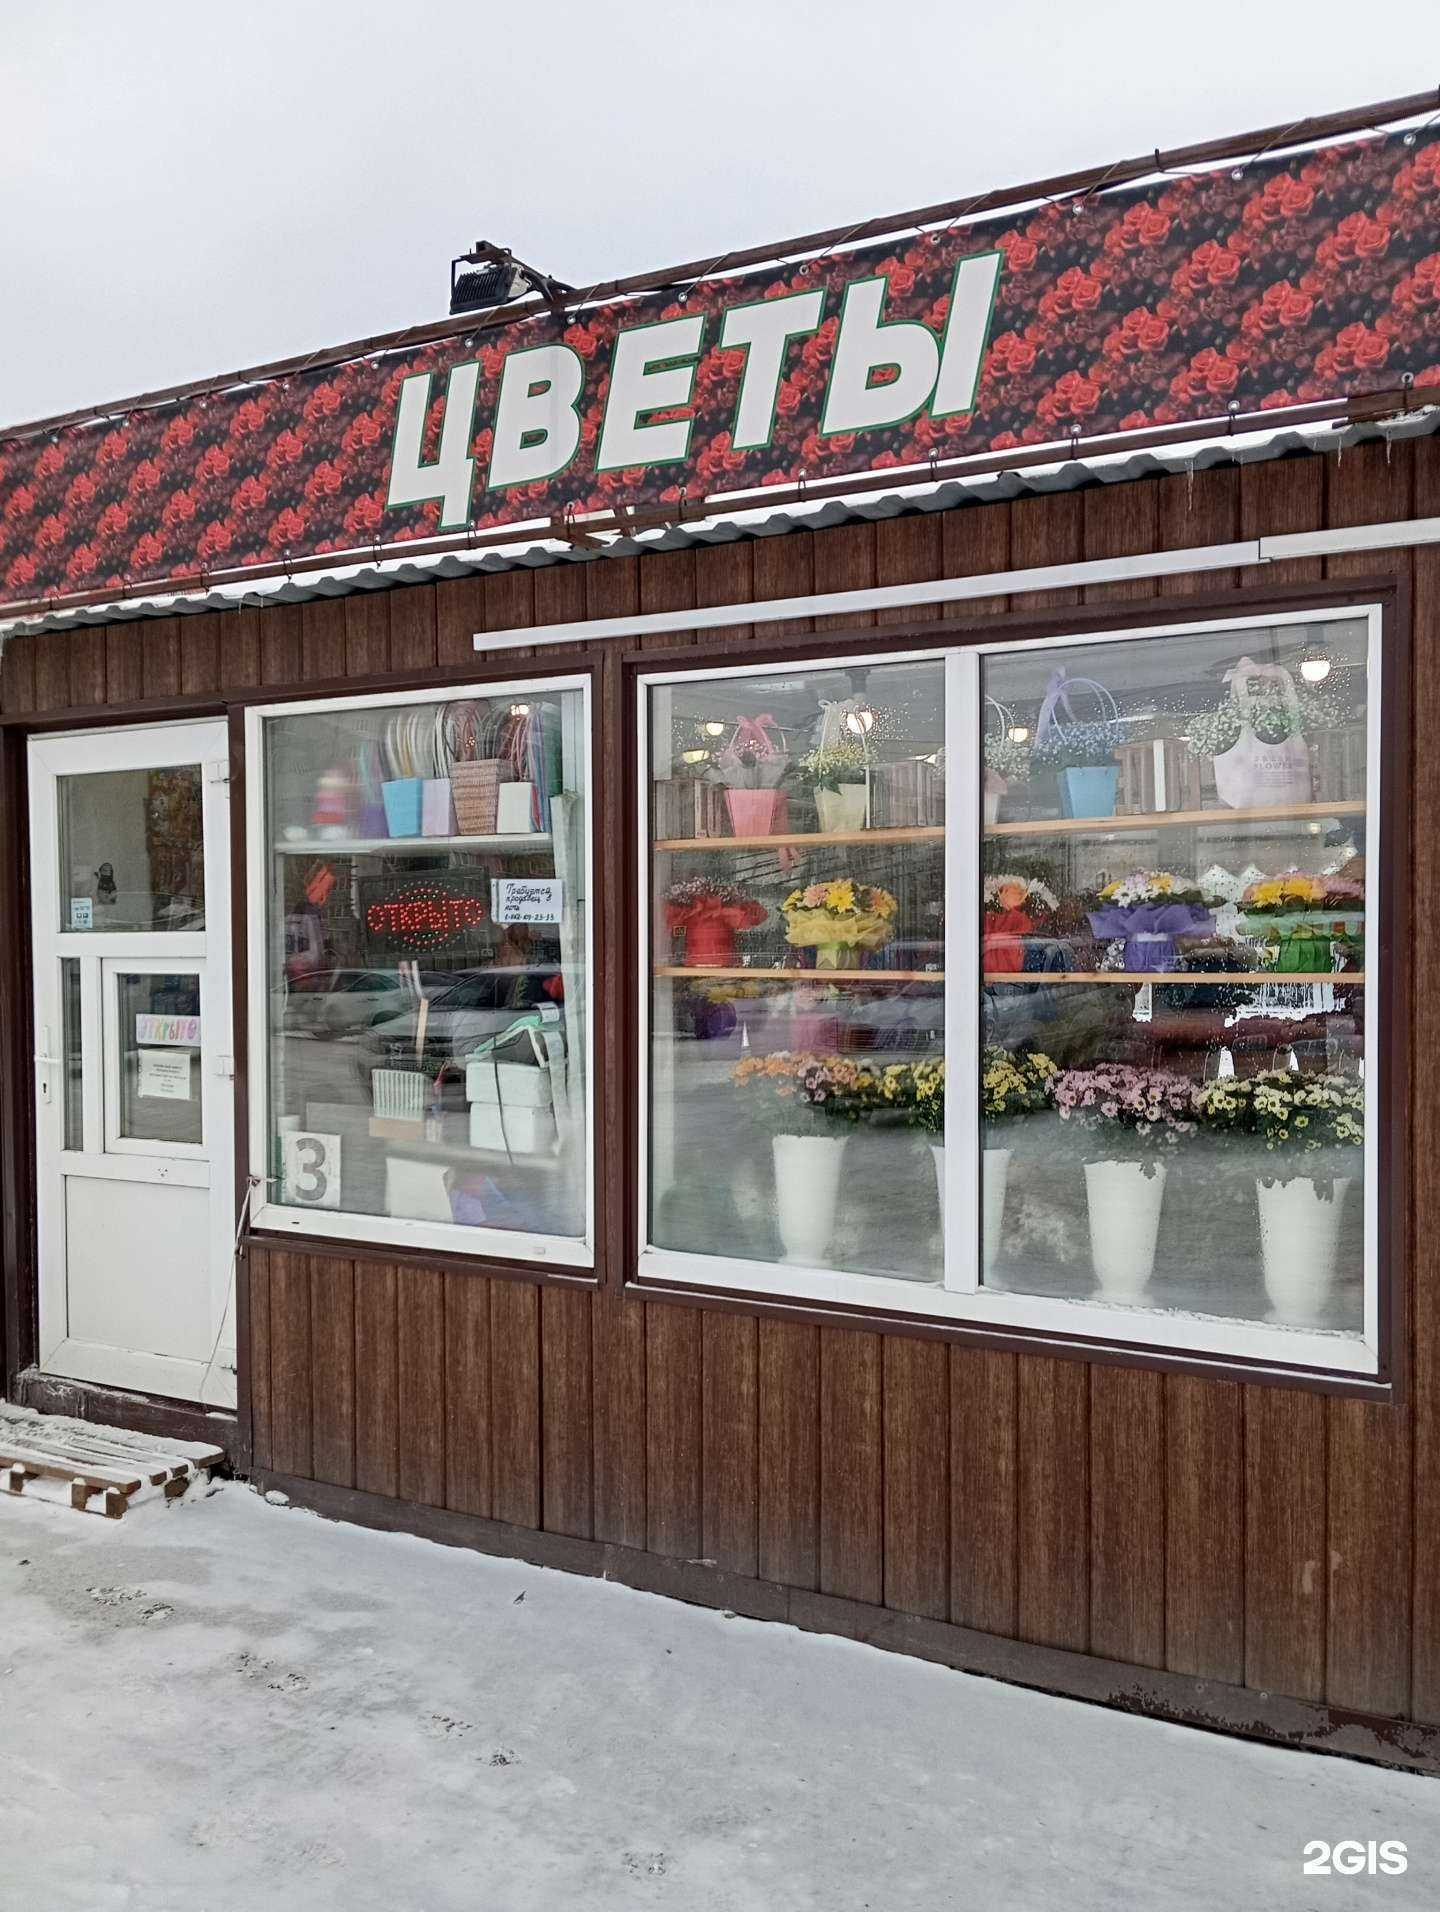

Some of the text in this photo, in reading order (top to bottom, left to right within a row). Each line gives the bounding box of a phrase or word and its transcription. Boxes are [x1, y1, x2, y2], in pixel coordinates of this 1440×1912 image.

[386, 249, 1004, 530] ЦВЕТЫ
[367, 898, 483, 933] ОТКРЫТО
[295, 1137, 328, 1202] 3
